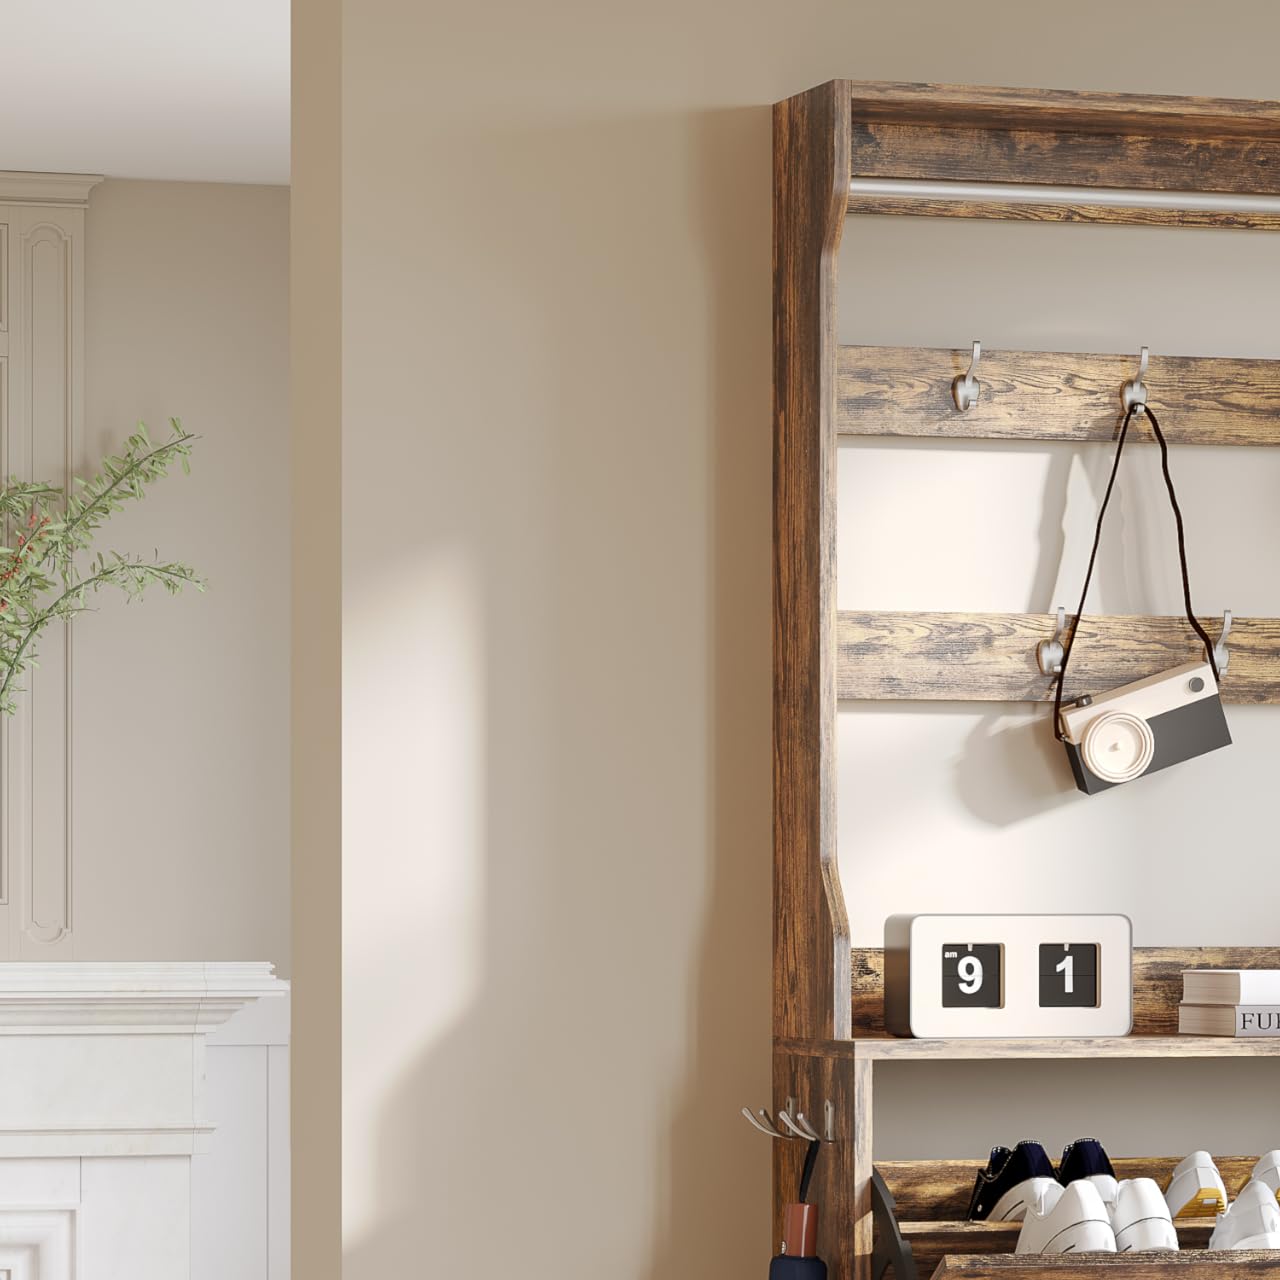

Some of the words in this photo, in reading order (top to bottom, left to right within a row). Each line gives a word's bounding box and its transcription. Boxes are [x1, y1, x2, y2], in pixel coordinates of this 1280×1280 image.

[944, 951, 958, 959] am
[957, 955, 984, 995] 9
[1055, 955, 1074, 993] 1
